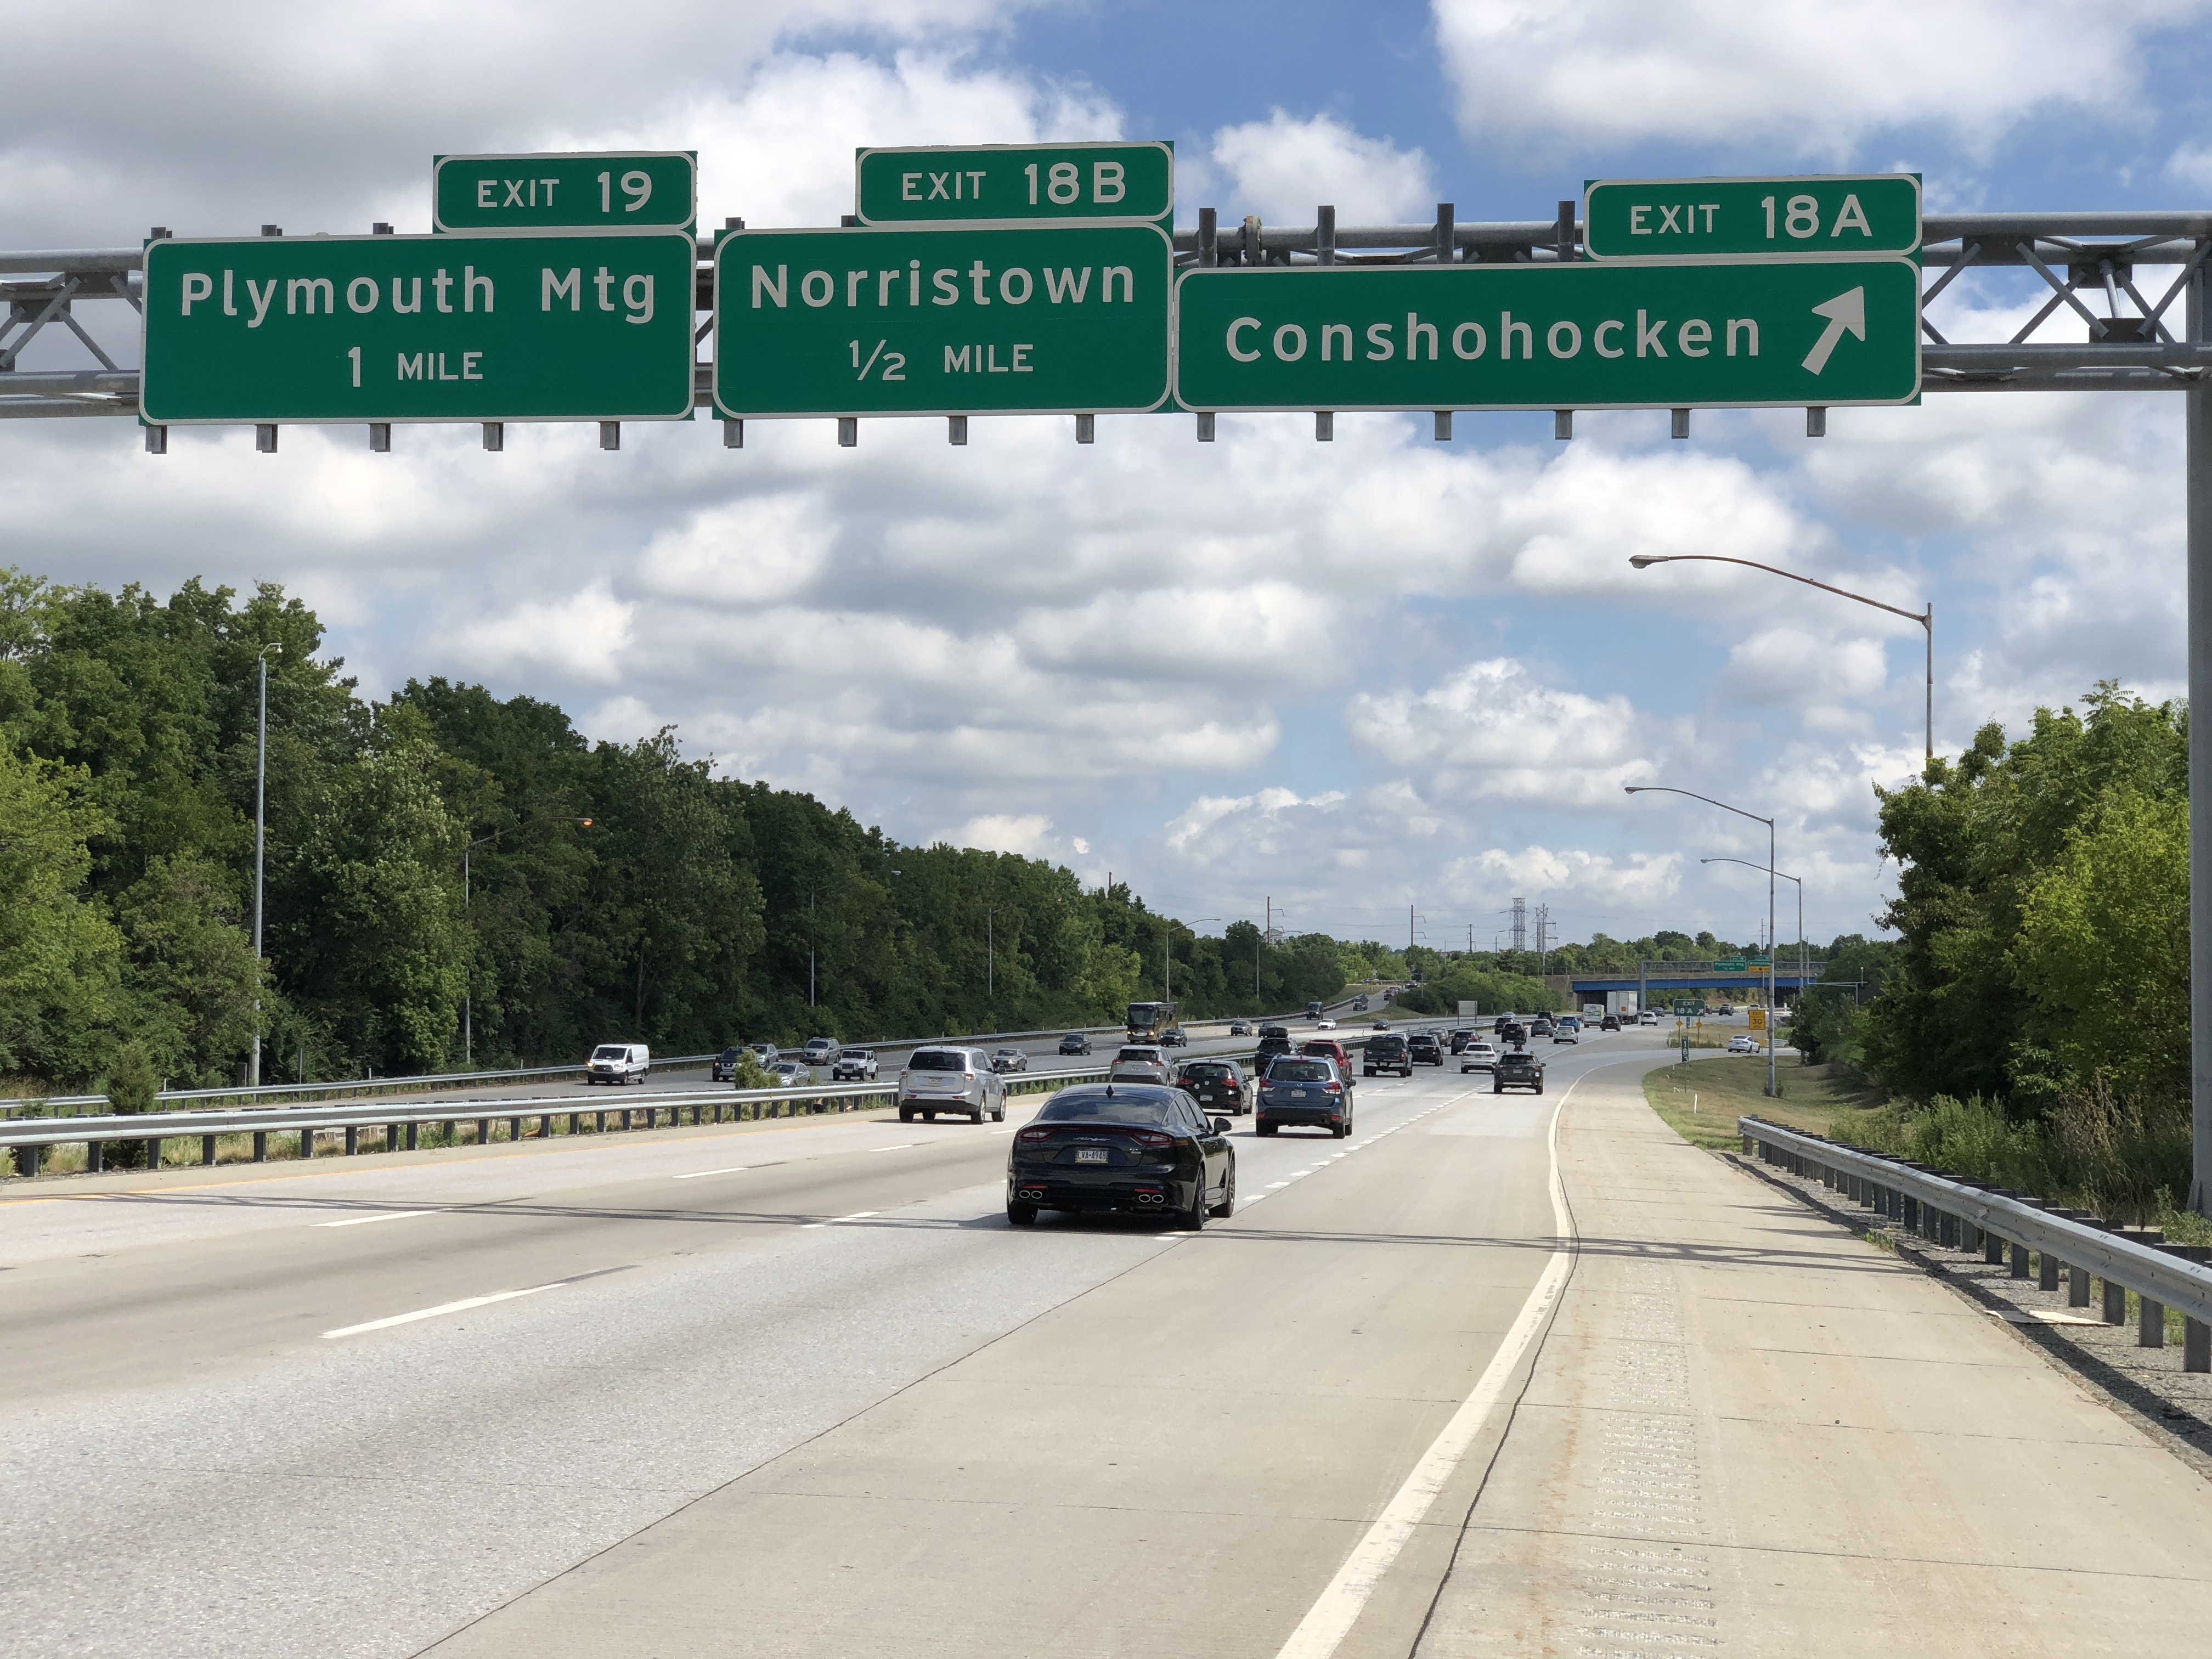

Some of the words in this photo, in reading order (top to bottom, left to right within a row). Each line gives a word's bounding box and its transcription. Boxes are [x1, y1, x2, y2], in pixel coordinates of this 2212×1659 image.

[478, 179, 559, 207] EXIT
[598, 171, 652, 212] 19
[903, 172, 986, 200] EXIT
[1025, 162, 1125, 204] 18B
[1631, 205, 1720, 234] EXIT
[1762, 194, 1872, 238] 18A
[182, 266, 494, 328] Plymouth
[542, 267, 653, 324] Mtg
[752, 259, 1133, 308] Norristown
[1227, 309, 1758, 362] Conshohocken
[348, 347, 360, 387] 1
[398, 352, 483, 380] MILE
[945, 345, 1033, 373] MILE
